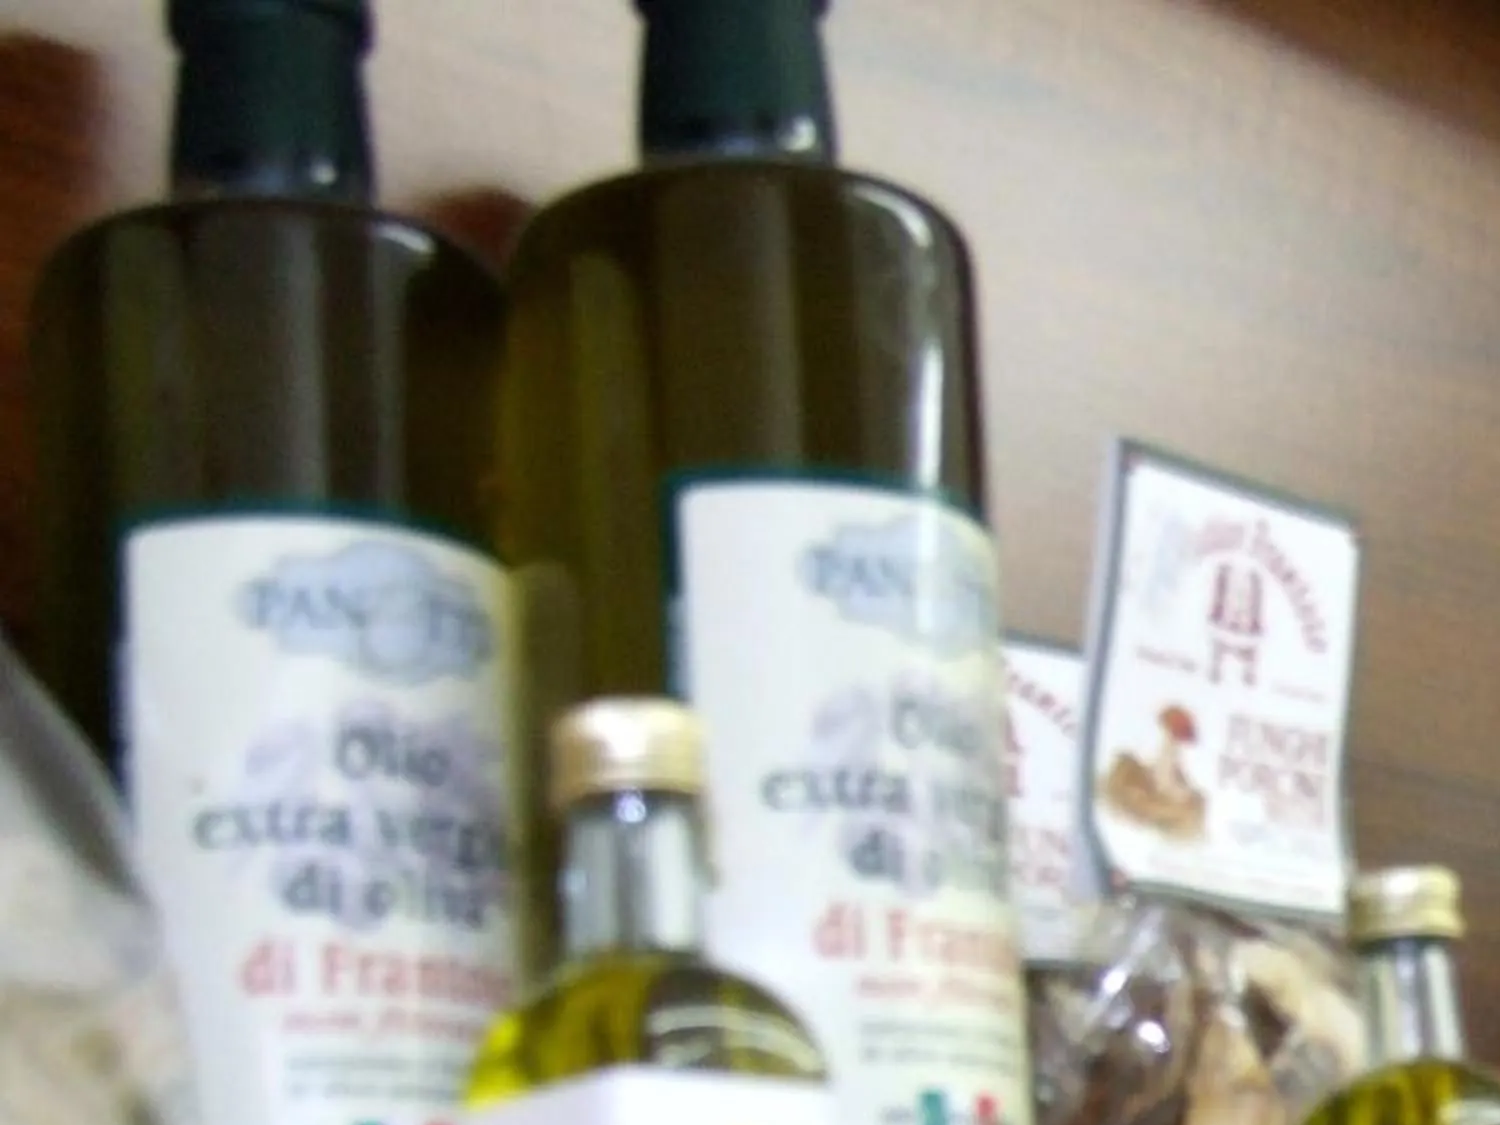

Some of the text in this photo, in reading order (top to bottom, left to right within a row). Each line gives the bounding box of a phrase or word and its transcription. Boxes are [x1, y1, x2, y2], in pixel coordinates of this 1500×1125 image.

[333, 720, 450, 786] Olio
[762, 772, 910, 813] extra
[192, 800, 354, 850] extra
[282, 860, 342, 914] di
[812, 902, 866, 960] di
[240, 934, 298, 998] di
